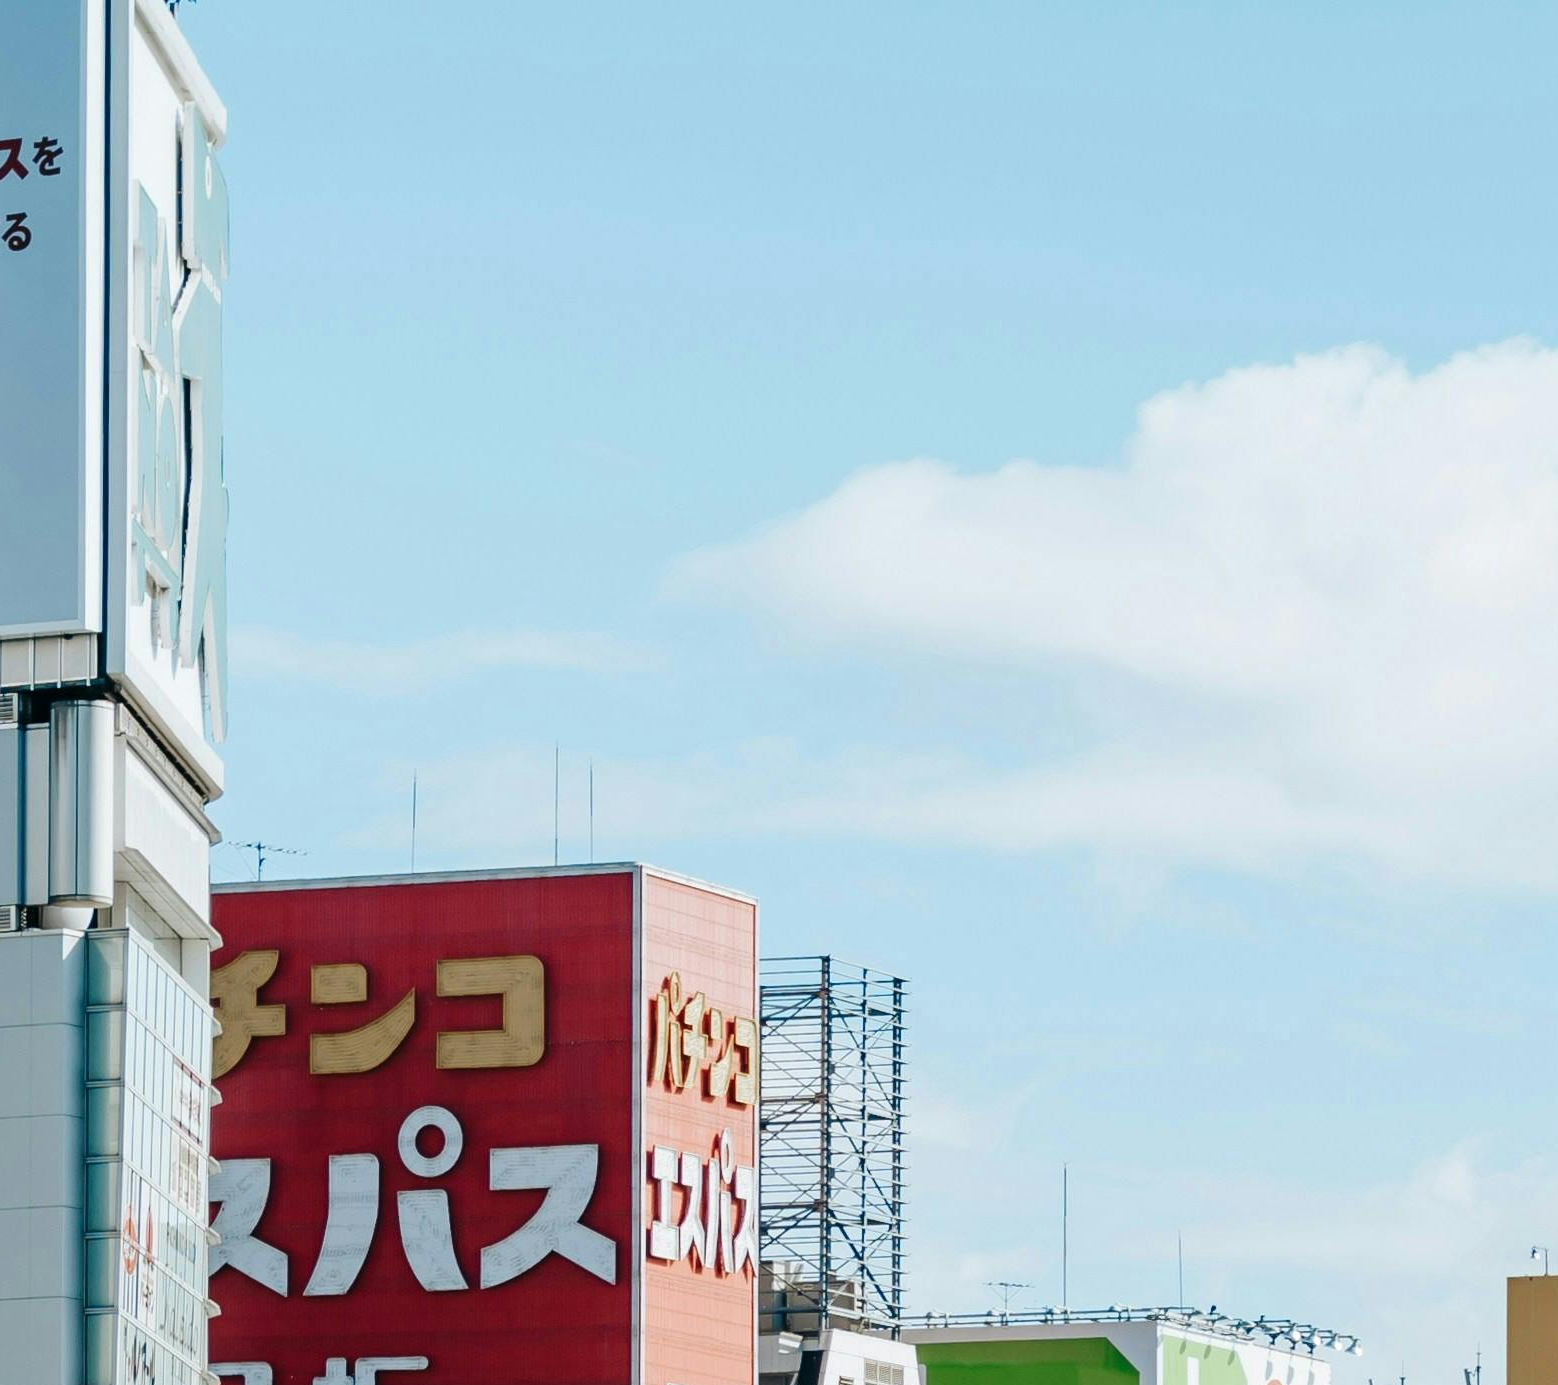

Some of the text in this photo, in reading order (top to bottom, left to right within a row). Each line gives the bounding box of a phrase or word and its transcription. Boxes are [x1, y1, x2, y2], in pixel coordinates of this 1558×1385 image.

[651, 970, 760, 1106] パチンコ
[649, 1128, 759, 1278] エスパス
